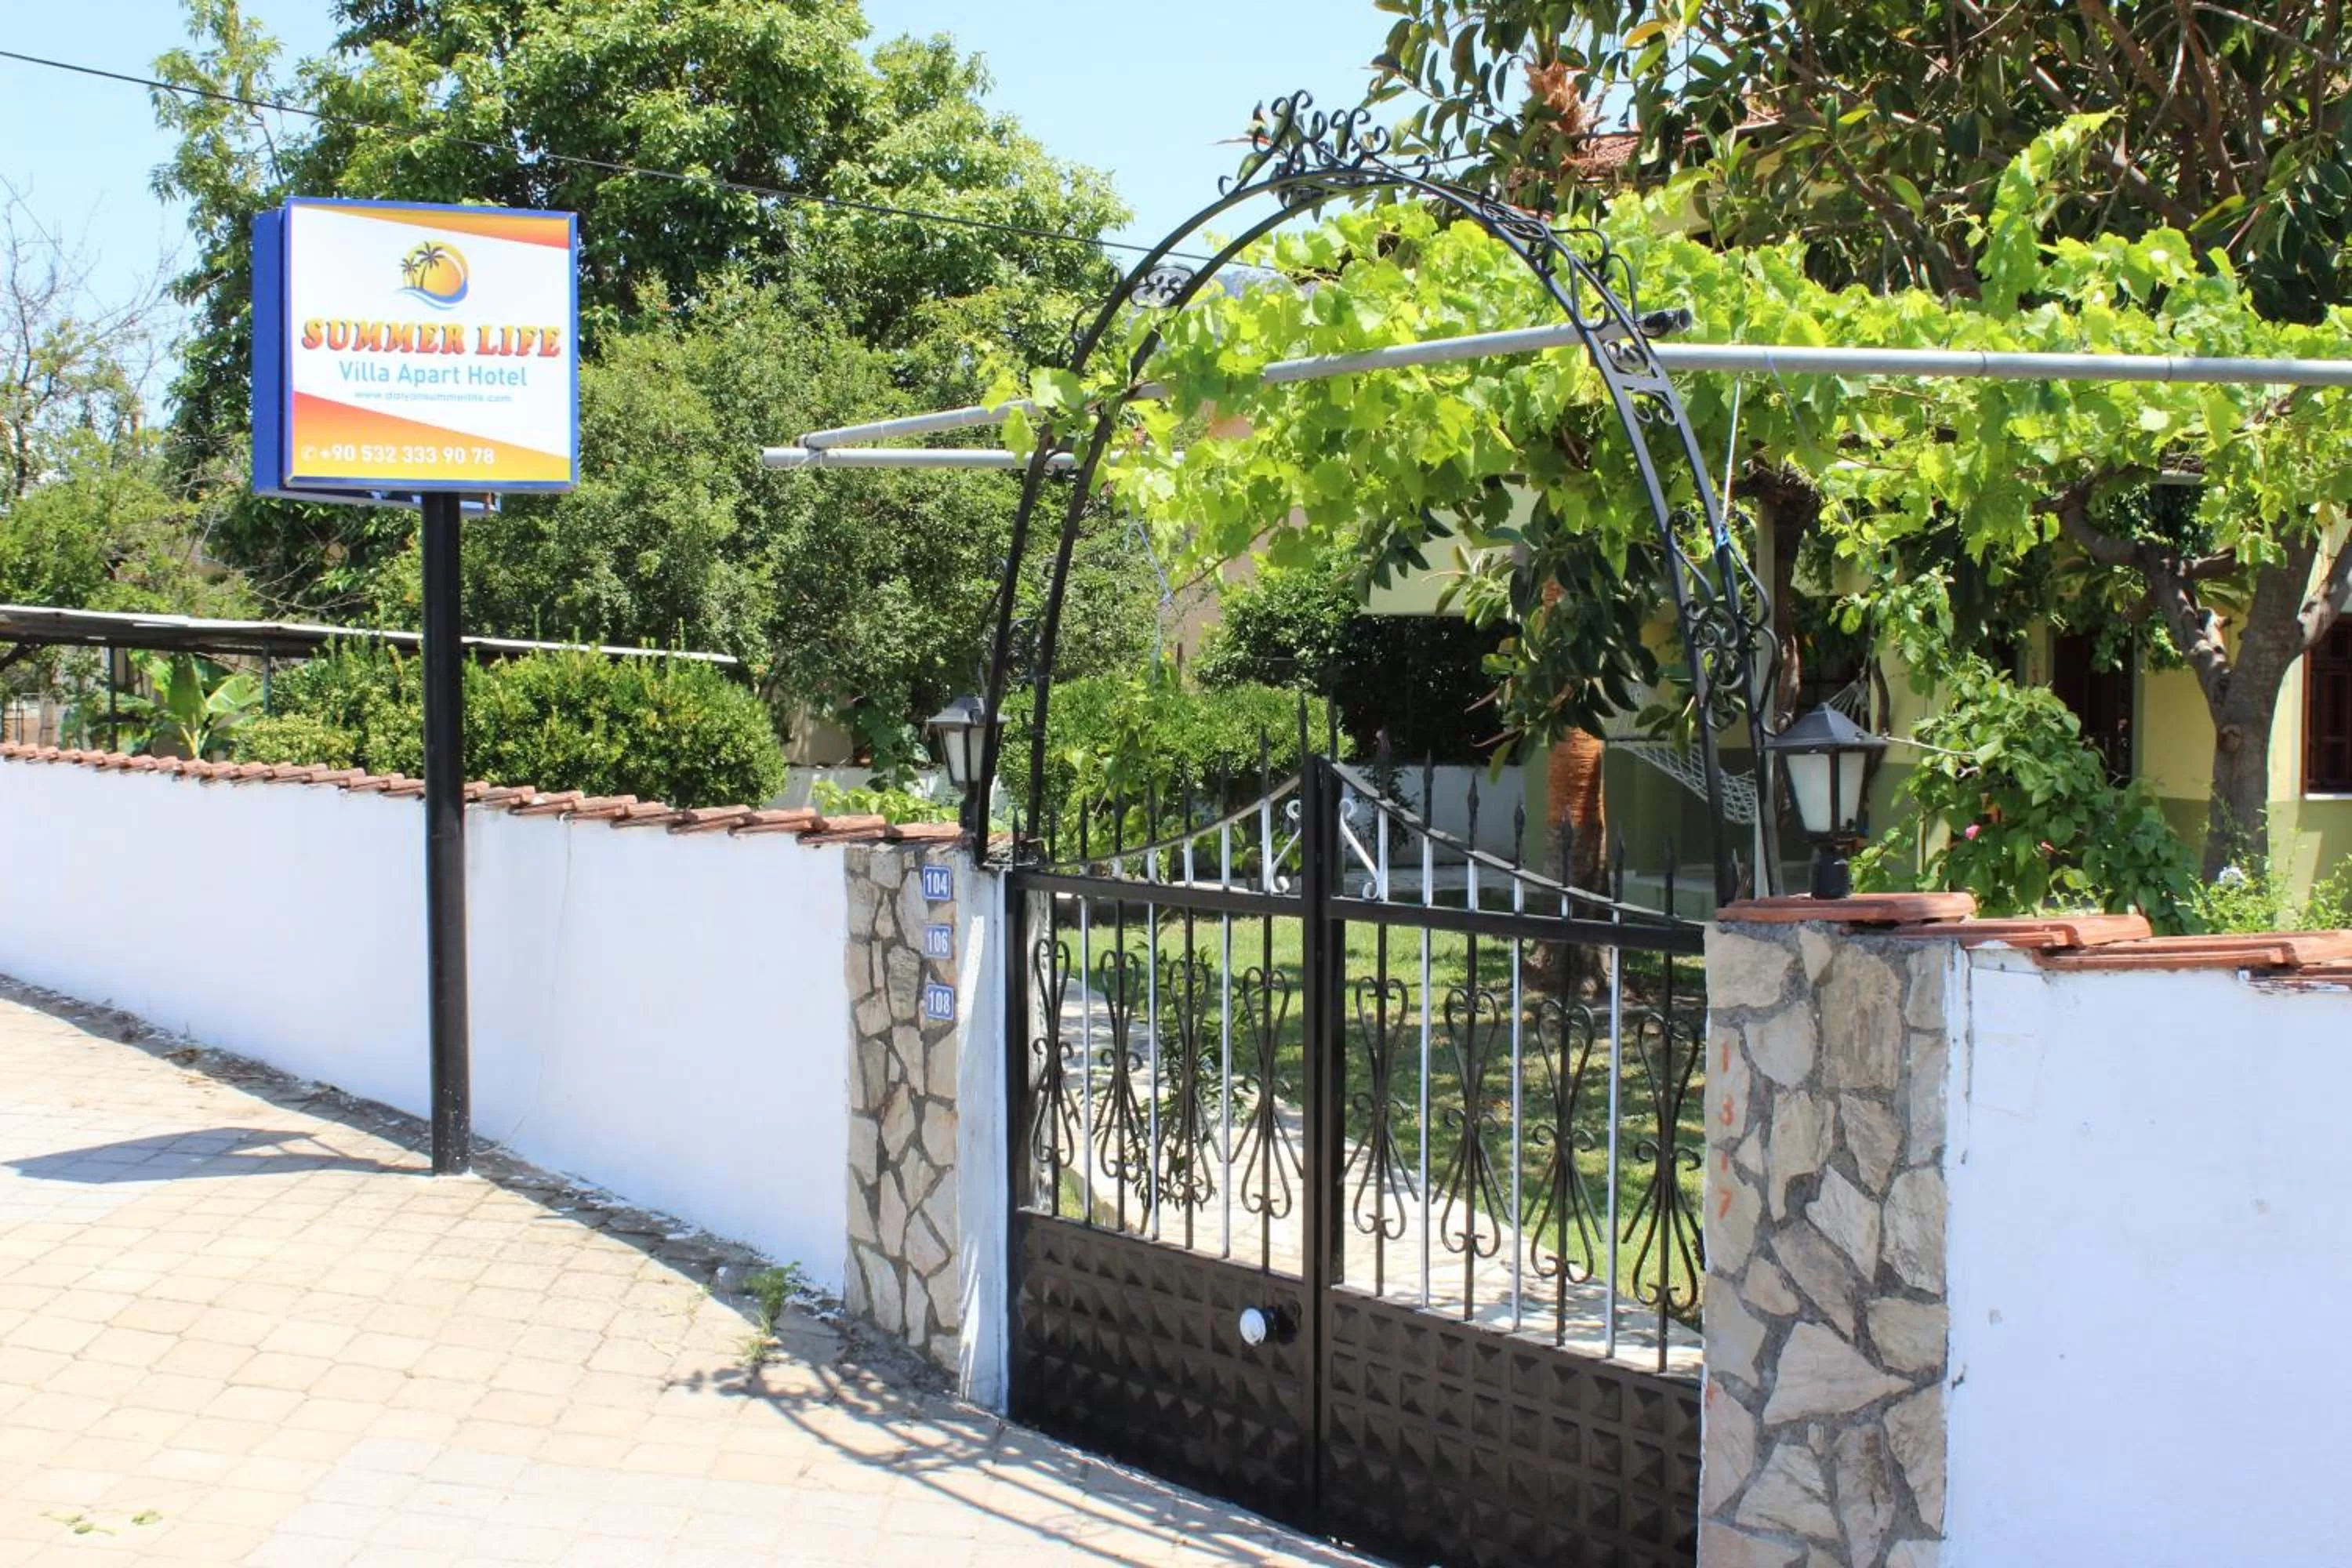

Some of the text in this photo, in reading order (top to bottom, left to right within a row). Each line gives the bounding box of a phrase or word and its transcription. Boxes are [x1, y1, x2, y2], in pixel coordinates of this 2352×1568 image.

[301, 317, 561, 358] SUMMER LIFE
[339, 360, 527, 387] Villa Apart Hotel
[361, 445, 397, 464] 532
[401, 446, 437, 464] 333
[443, 447, 466, 464] 90
[471, 448, 495, 465] 78
[926, 873, 948, 895] 104
[927, 931, 949, 953] 106
[928, 992, 951, 1014] 108
